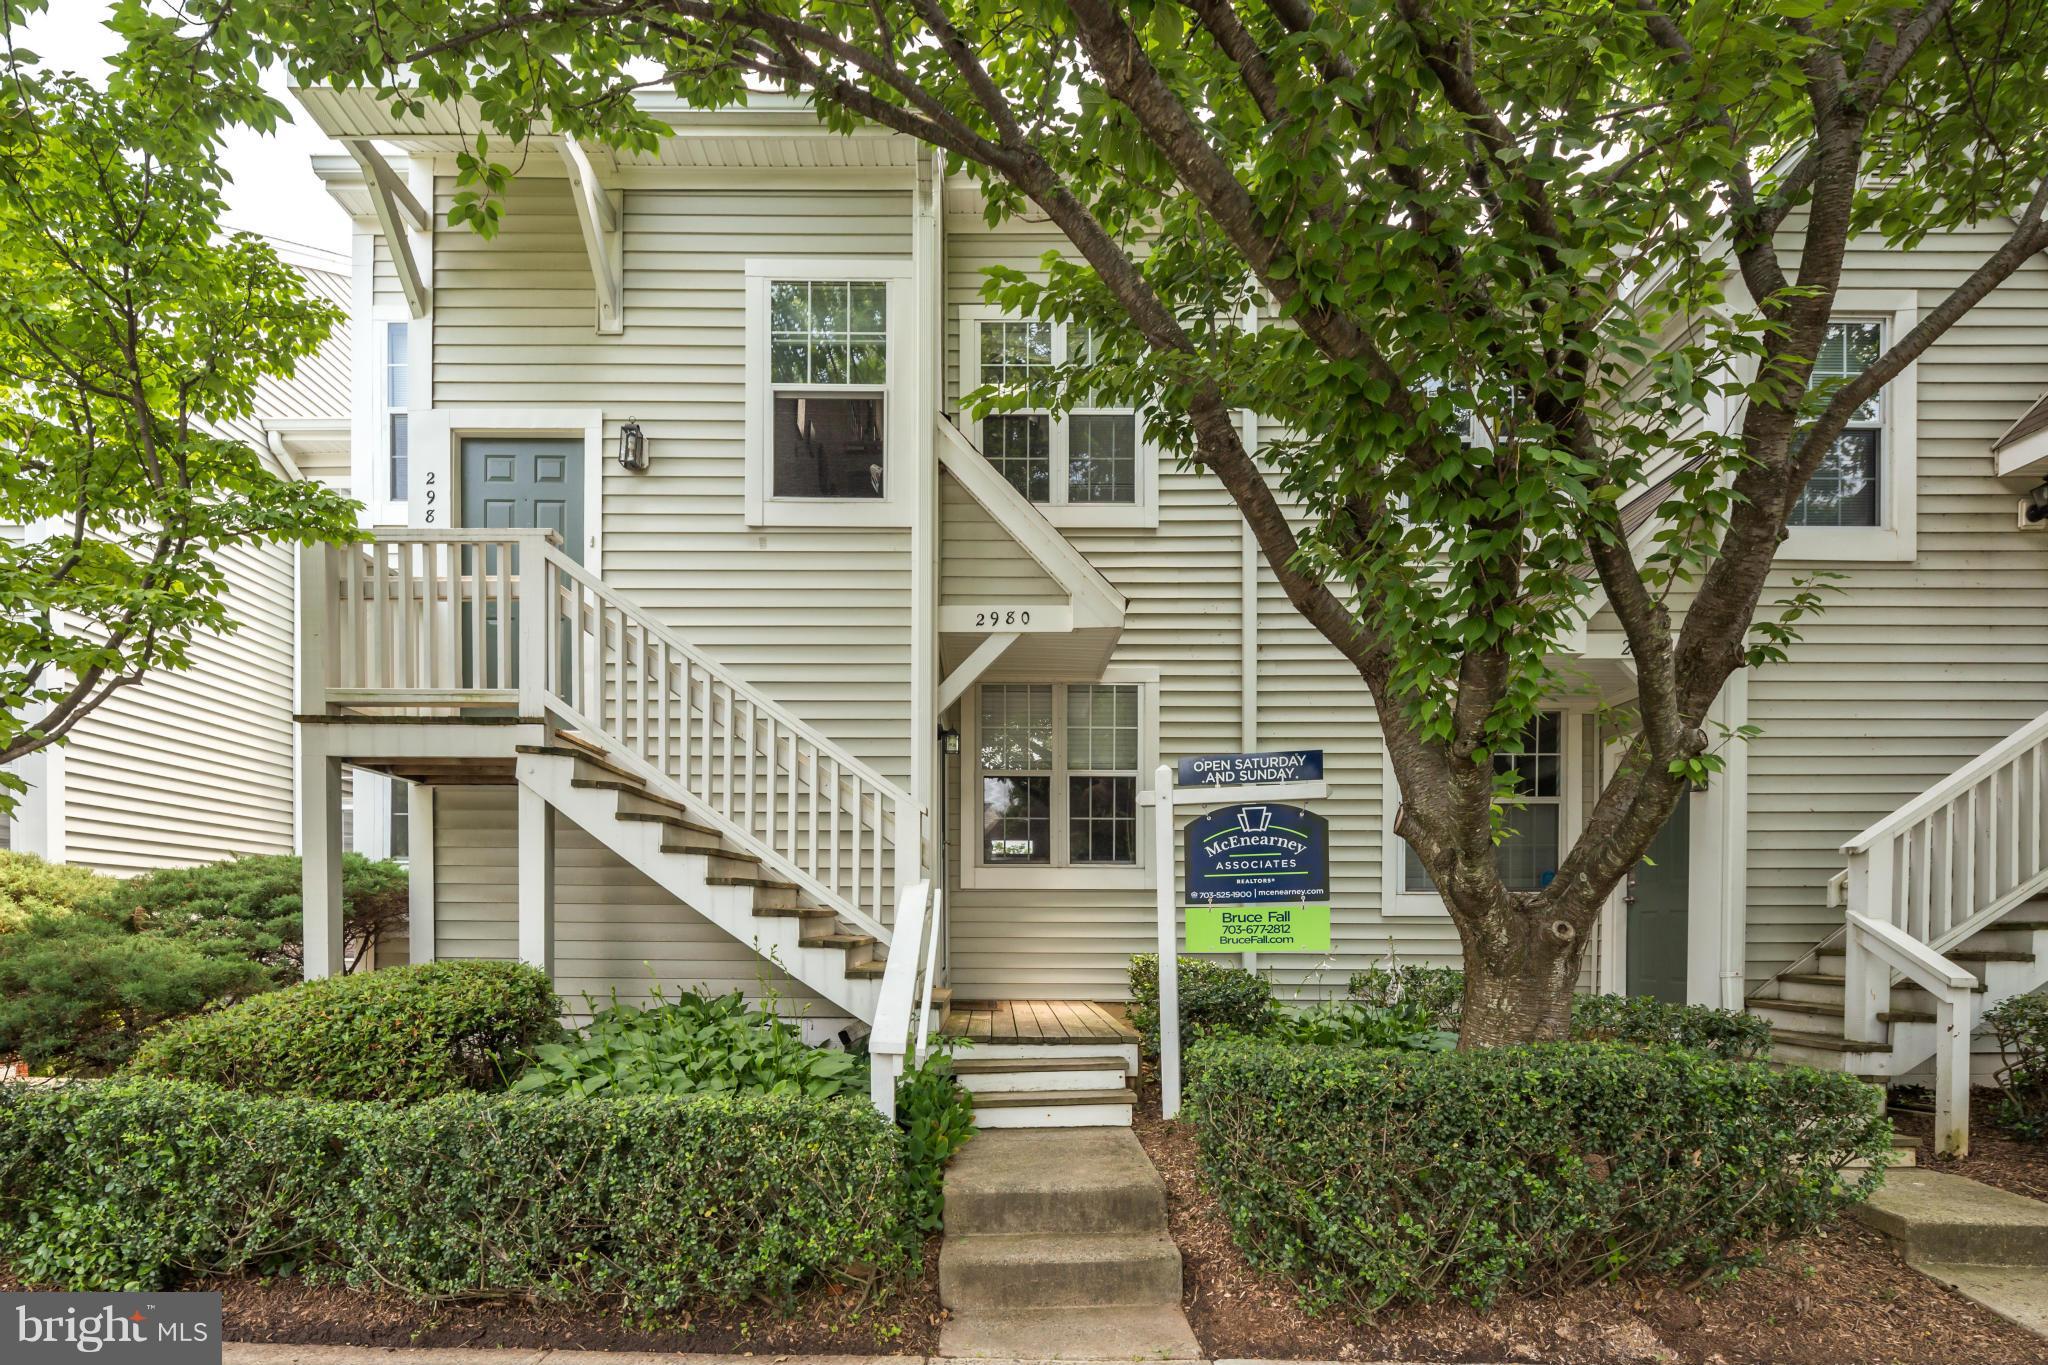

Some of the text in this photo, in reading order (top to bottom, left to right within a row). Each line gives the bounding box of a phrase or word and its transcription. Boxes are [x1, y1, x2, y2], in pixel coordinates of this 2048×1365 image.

[976, 611, 1030, 627] 2980
[1193, 755, 1306, 772] OPEN SATURDAY
[1205, 768, 1295, 783] AND SUNDAY
[1204, 835, 1307, 857] McEnearney
[1216, 859, 1297, 870] ASSOCIATES
[1199, 888, 1324, 899] 703-525-1900 mcenearney.com
[1222, 911, 1291, 923] Bruce Fall
[1222, 924, 1291, 935] 703-677-2812
[1220, 936, 1294, 945] BruceFall.com
